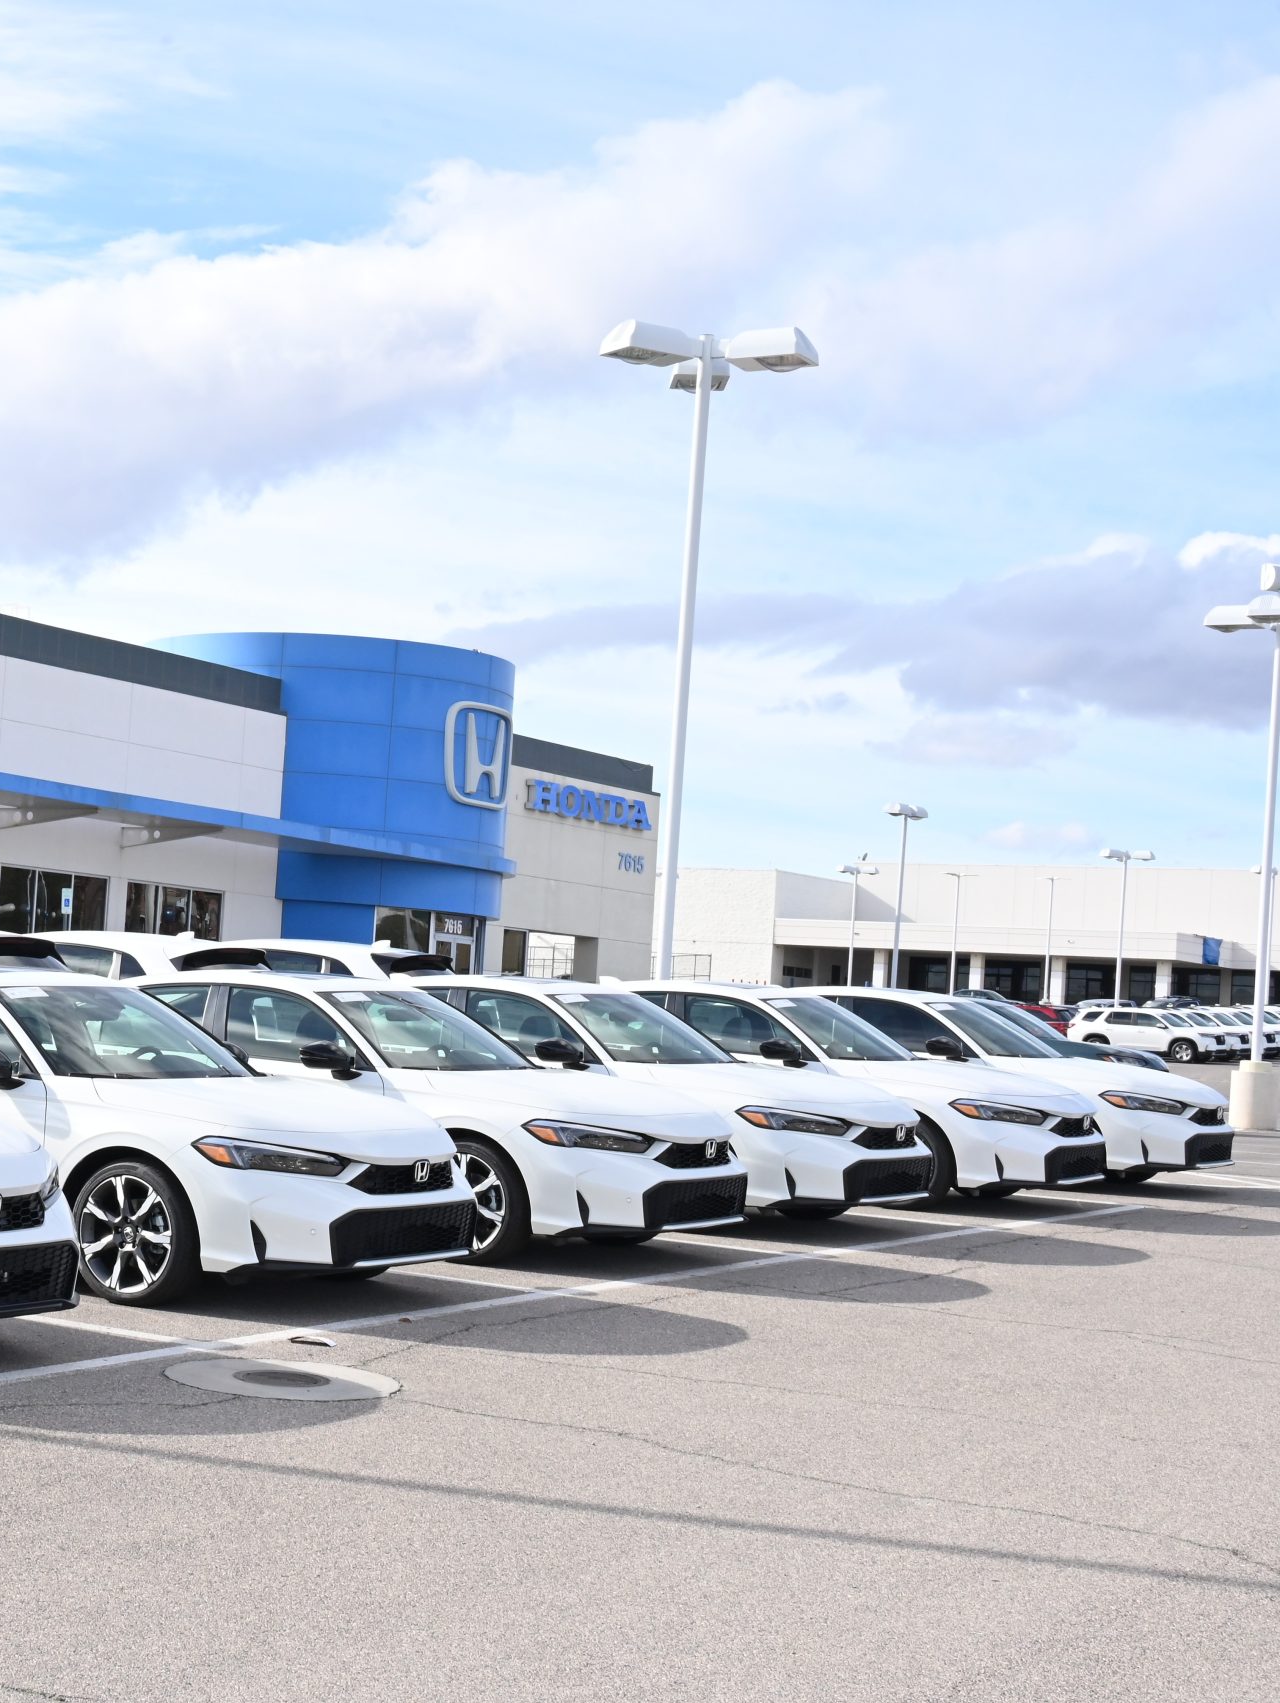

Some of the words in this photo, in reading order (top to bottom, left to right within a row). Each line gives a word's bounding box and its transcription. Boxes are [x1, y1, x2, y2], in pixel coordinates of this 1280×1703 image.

[463, 710, 508, 800] H
[525, 778, 652, 831] HONDA
[617, 852, 645, 874] 7615
[444, 918, 463, 935] 7615
